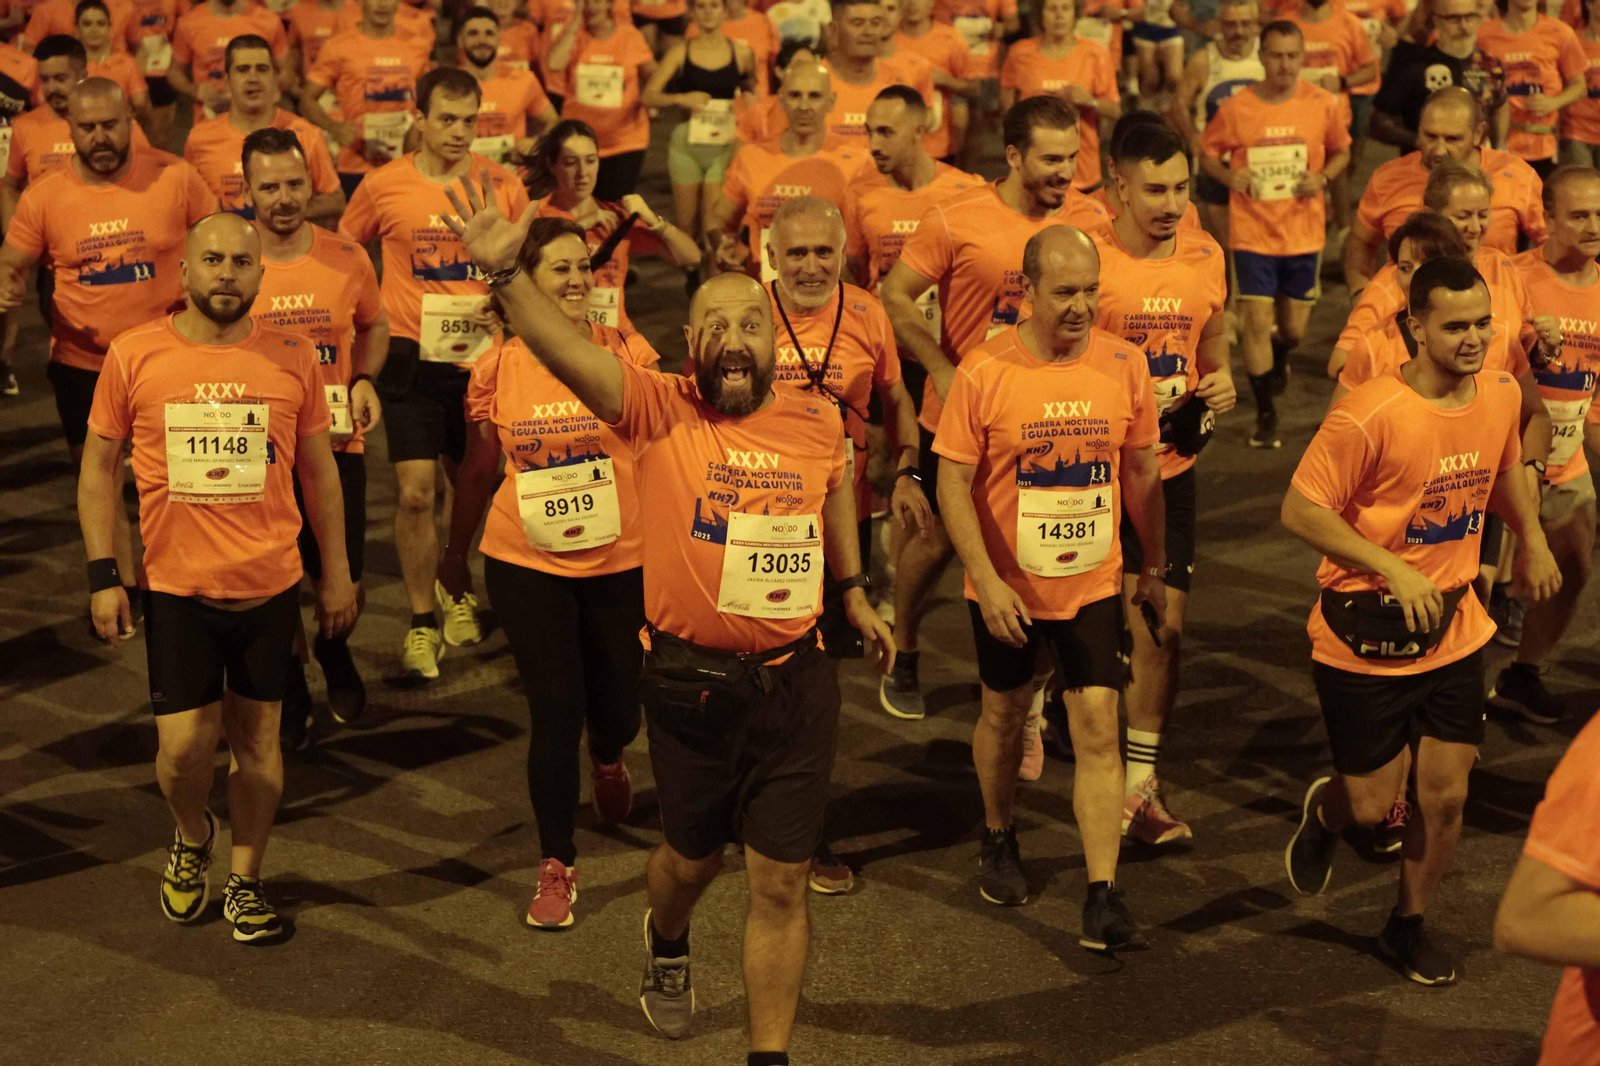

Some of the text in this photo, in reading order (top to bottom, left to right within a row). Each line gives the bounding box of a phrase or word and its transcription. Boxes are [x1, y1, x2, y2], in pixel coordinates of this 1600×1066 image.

[1265, 126, 1296, 138] XXXV
[772, 183, 812, 198] XXXV
[90, 217, 128, 237] XXXV
[81, 235, 146, 252] GUADALQUIVIR
[270, 293, 315, 311] XXXV
[1142, 297, 1182, 313] XXXV
[290, 308, 331, 316] NOCTURNA
[1158, 314, 1194, 322] NOCTURNA
[1559, 316, 1597, 335] XXXV
[778, 347, 827, 363] XXXV
[194, 383, 246, 399] XXXV
[532, 401, 581, 420] XXXV
[1043, 401, 1092, 419] XXXV
[511, 414, 600, 428] CARRERA NOCTURNA
[517, 421, 600, 437] GUADALQUIVIR
[1021, 419, 1109, 430] CARRERA NOCTURNA
[1027, 426, 1110, 440] GUADALQUIVIR
[187, 436, 248, 455] 11148
[727, 447, 779, 469] XXXV
[1439, 451, 1480, 475] XXXV
[708, 461, 802, 481] CARRERA NOCTURNA
[1423, 468, 1491, 488] CARRERA NOCTURNA
[713, 473, 804, 491] GUADALQUIVIR
[1429, 476, 1490, 495] GUADALQUIVIR
[545, 493, 594, 518] 8919
[1037, 519, 1096, 540] 14381
[748, 552, 811, 574] 13035
[1361, 640, 1420, 656] FILA
